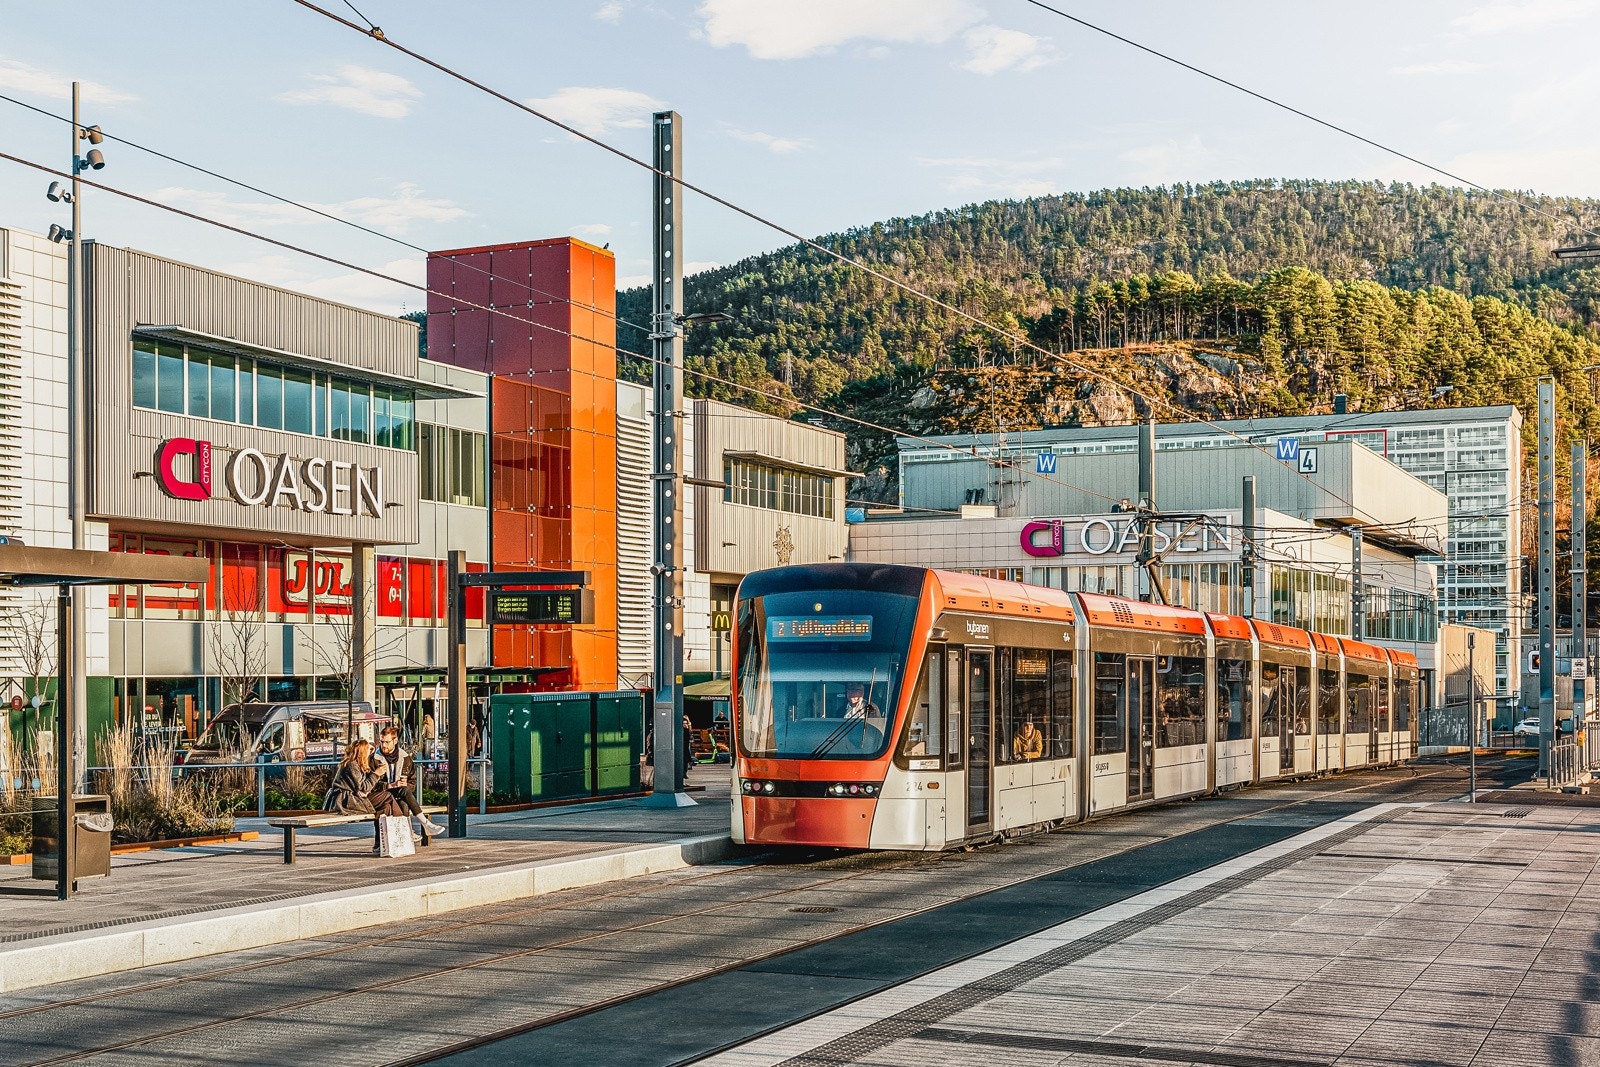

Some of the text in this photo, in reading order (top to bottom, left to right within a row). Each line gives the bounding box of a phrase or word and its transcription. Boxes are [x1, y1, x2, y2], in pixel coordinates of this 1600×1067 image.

[1279, 440, 1298, 458] W
[202, 443, 210, 485] CITYCON
[1038, 455, 1056, 472] W
[1303, 450, 1313, 471] 4
[231, 447, 383, 519] OASEN
[1080, 514, 1233, 555] OASEN
[778, 619, 869, 636] 2 Fyllingsdalen
[966, 619, 989, 636] bybanen
